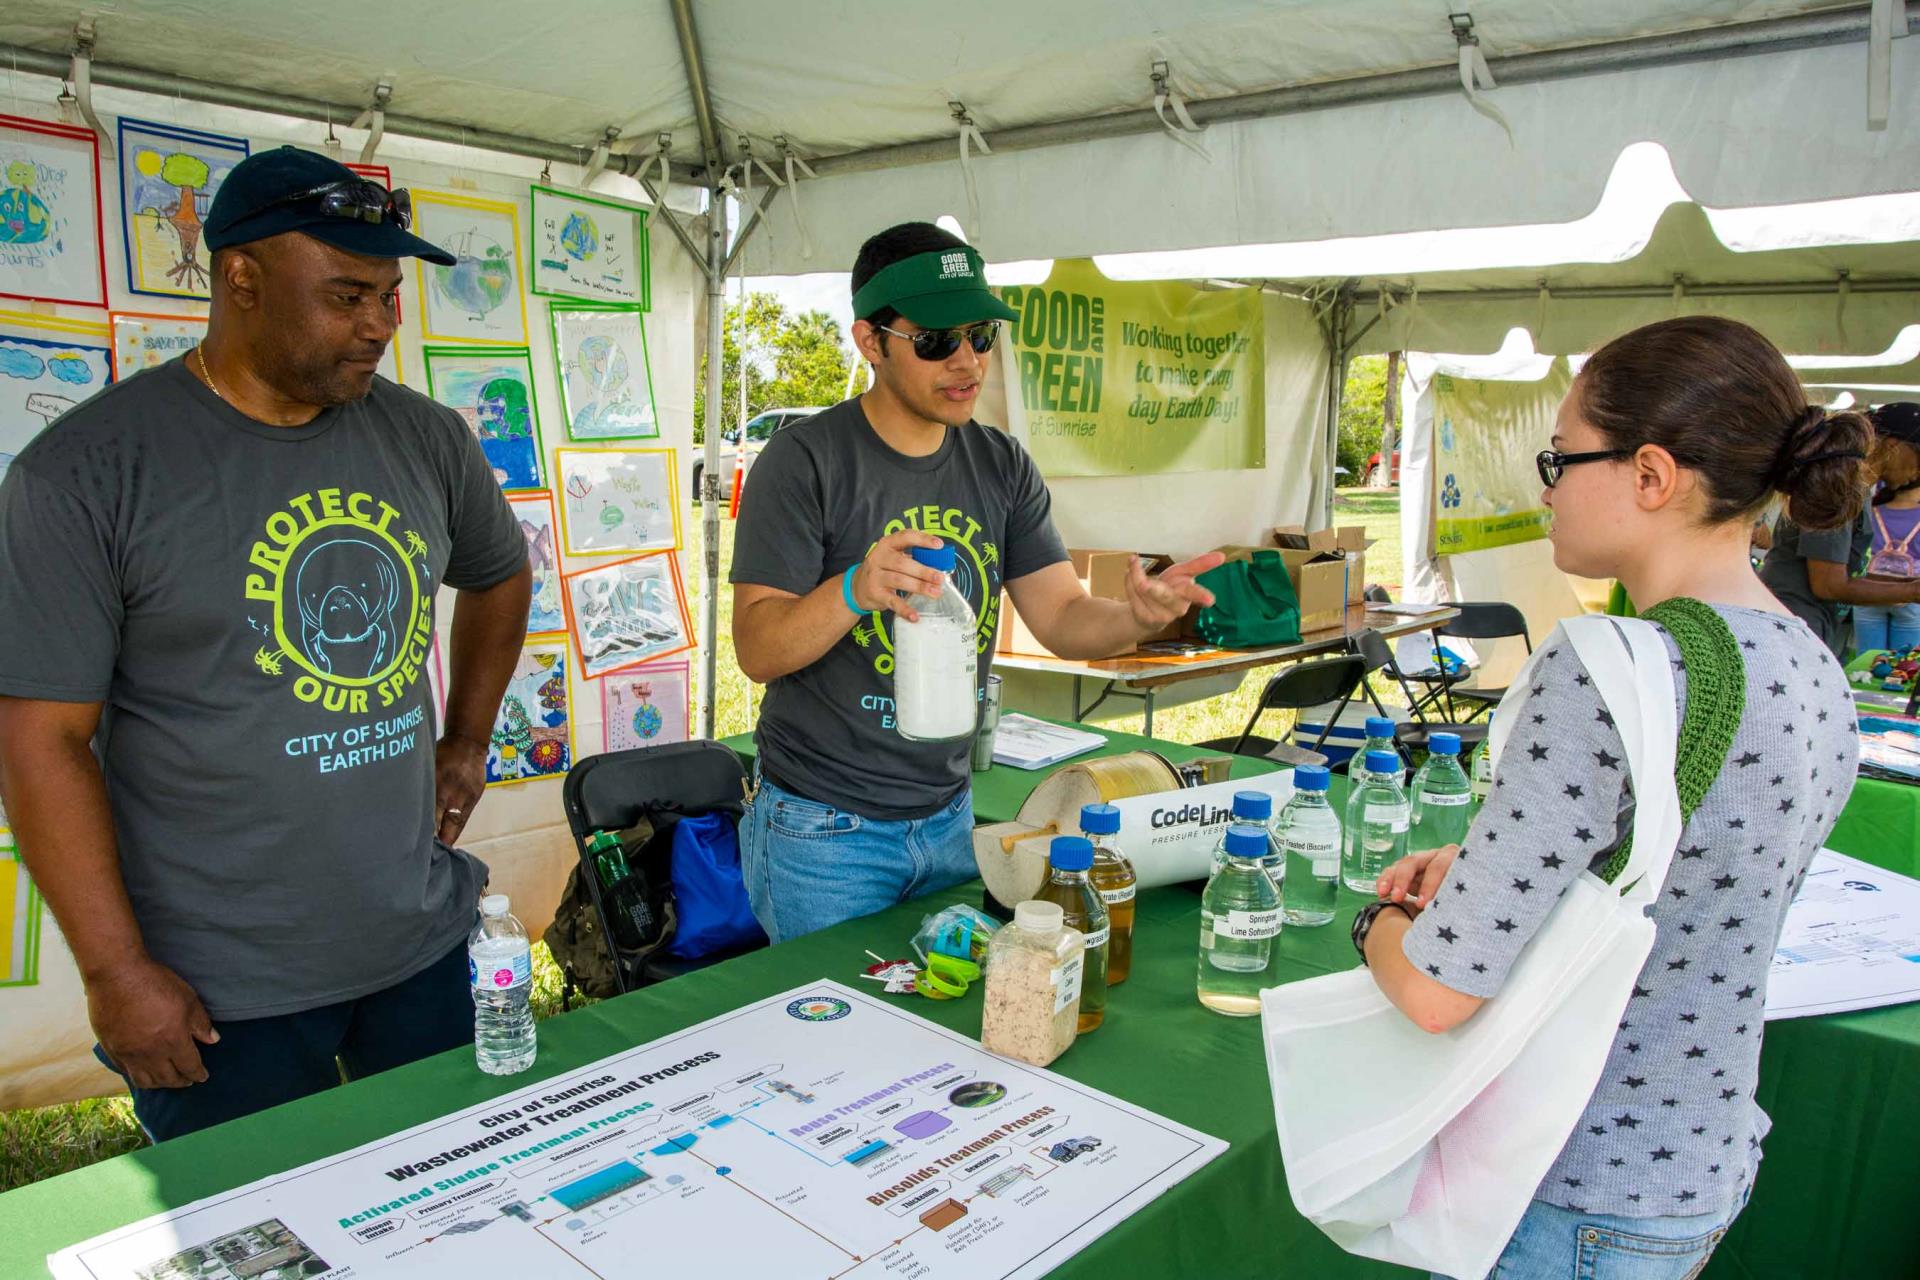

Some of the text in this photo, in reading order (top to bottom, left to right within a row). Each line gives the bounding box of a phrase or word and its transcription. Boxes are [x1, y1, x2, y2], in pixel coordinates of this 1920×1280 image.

[941, 253, 963, 265] GOOD
[943, 262, 970, 274] GREEN
[1091, 296, 1104, 354] AND
[1122, 321, 1250, 359] Working together
[1020, 351, 1104, 413] REEN
[1136, 360, 1234, 390] to make every
[1128, 395, 1239, 424] day Earth Day!
[1030, 416, 1097, 437] of Sunrise
[868, 505, 982, 552] OTECT
[245, 487, 401, 602] PROTECT
[976, 596, 999, 655] CIES
[293, 594, 432, 713] OUR SPECIES
[861, 694, 896, 713] CITY
[285, 704, 425, 756] CITY OF SUNRISE
[319, 732, 417, 774] EARTH DAY
[1151, 830, 1198, 845] PRESSURE
[1283, 838, 1306, 850] Treated
[1231, 926, 1247, 937] Lime
[479, 1074, 617, 1129] City of Sunrise
[788, 1062, 956, 1137] Reuse Treatment Process
[876, 1102, 902, 1116] Storage
[384, 1051, 722, 1182] Wastewater Treatment Process
[1028, 1124, 1054, 1138] Disposal
[550, 1129, 627, 1162] Secondary Treatment
[866, 1105, 1056, 1207] Biosolids Treatment Process
[338, 1101, 655, 1229] Activated Sludge Treatment Process
[964, 1153, 1001, 1173] Dewatering
[418, 1182, 495, 1215] Primary Treatment
[901, 1187, 940, 1209] Thickening
[356, 1219, 393, 1237] Influent
[365, 1224, 395, 1240] Intake
[946, 1223, 973, 1241] Dissolved
[992, 1215, 999, 1223] or
